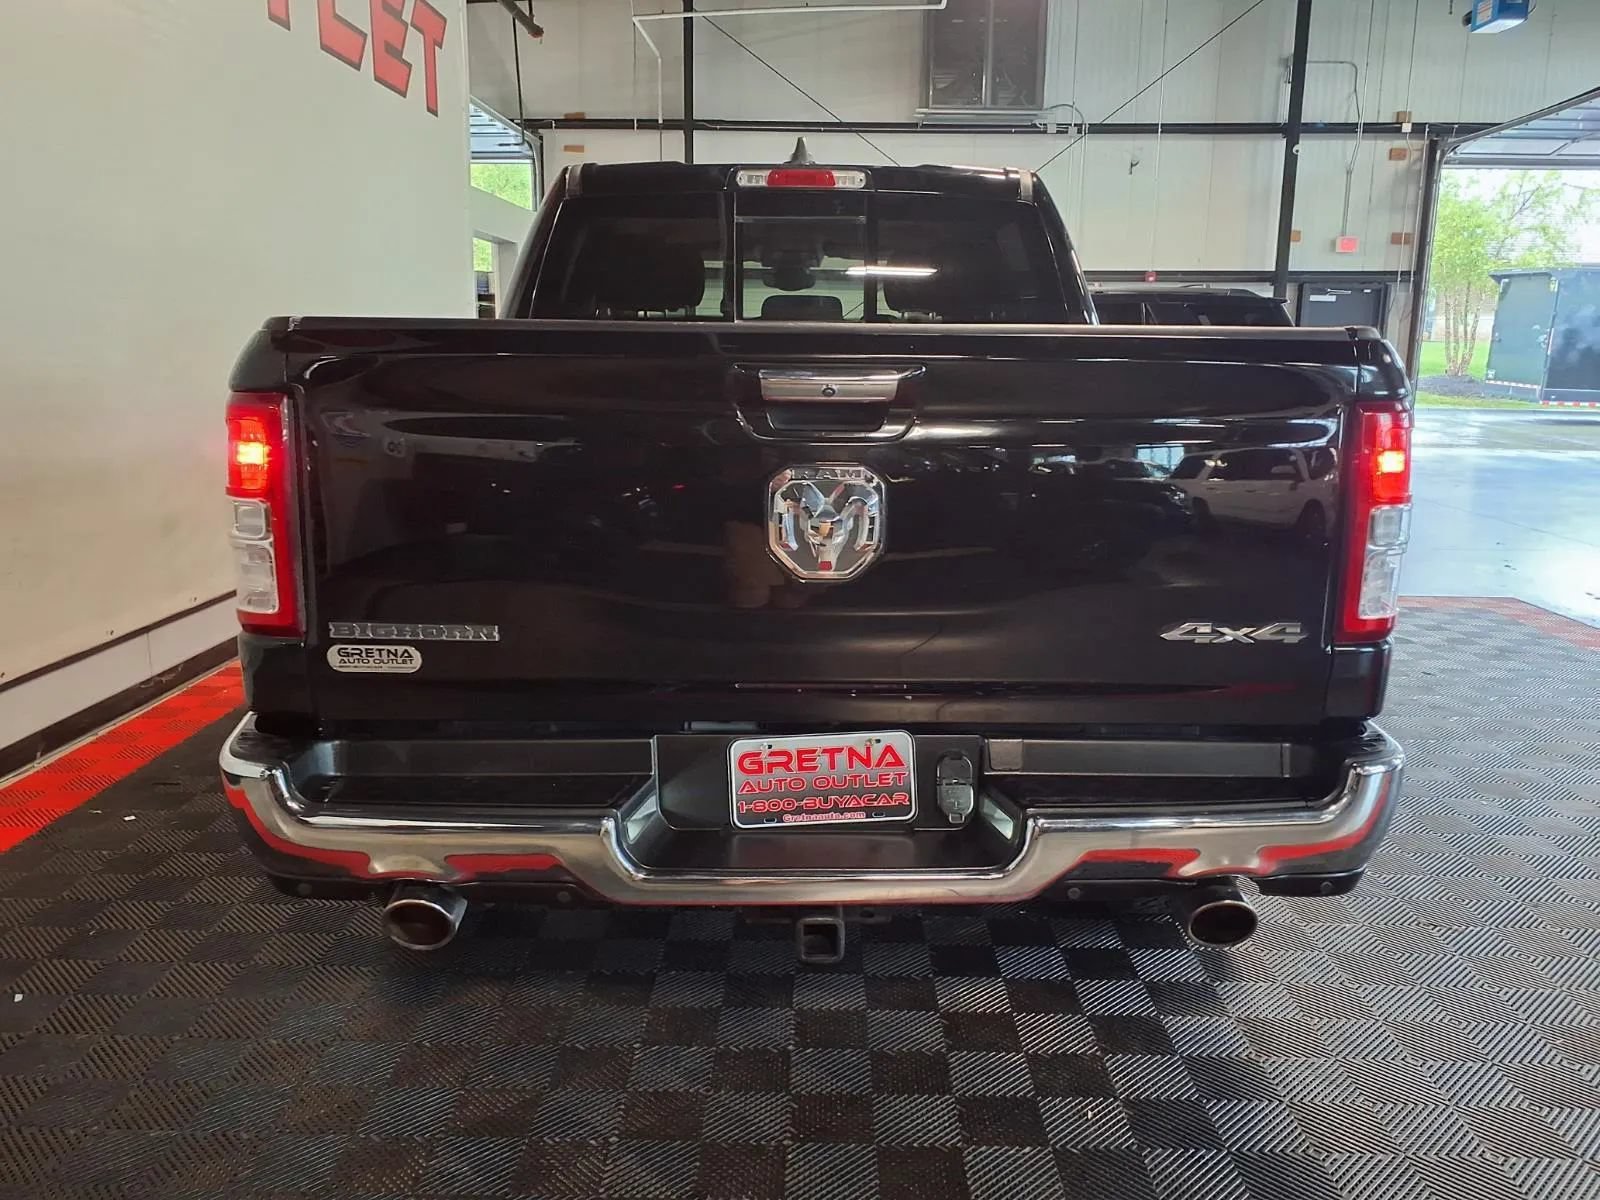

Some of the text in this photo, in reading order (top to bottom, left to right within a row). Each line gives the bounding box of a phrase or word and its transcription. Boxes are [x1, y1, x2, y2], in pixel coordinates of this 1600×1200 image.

[791, 465, 865, 480] RAM
[337, 647, 413, 659] GRETNA
[737, 744, 906, 775] GRETNA
[738, 772, 909, 794] AUTO OUTLET
[738, 792, 910, 814] 1-800-BUYACAR
[783, 811, 866, 822] Gretnaauto.com
